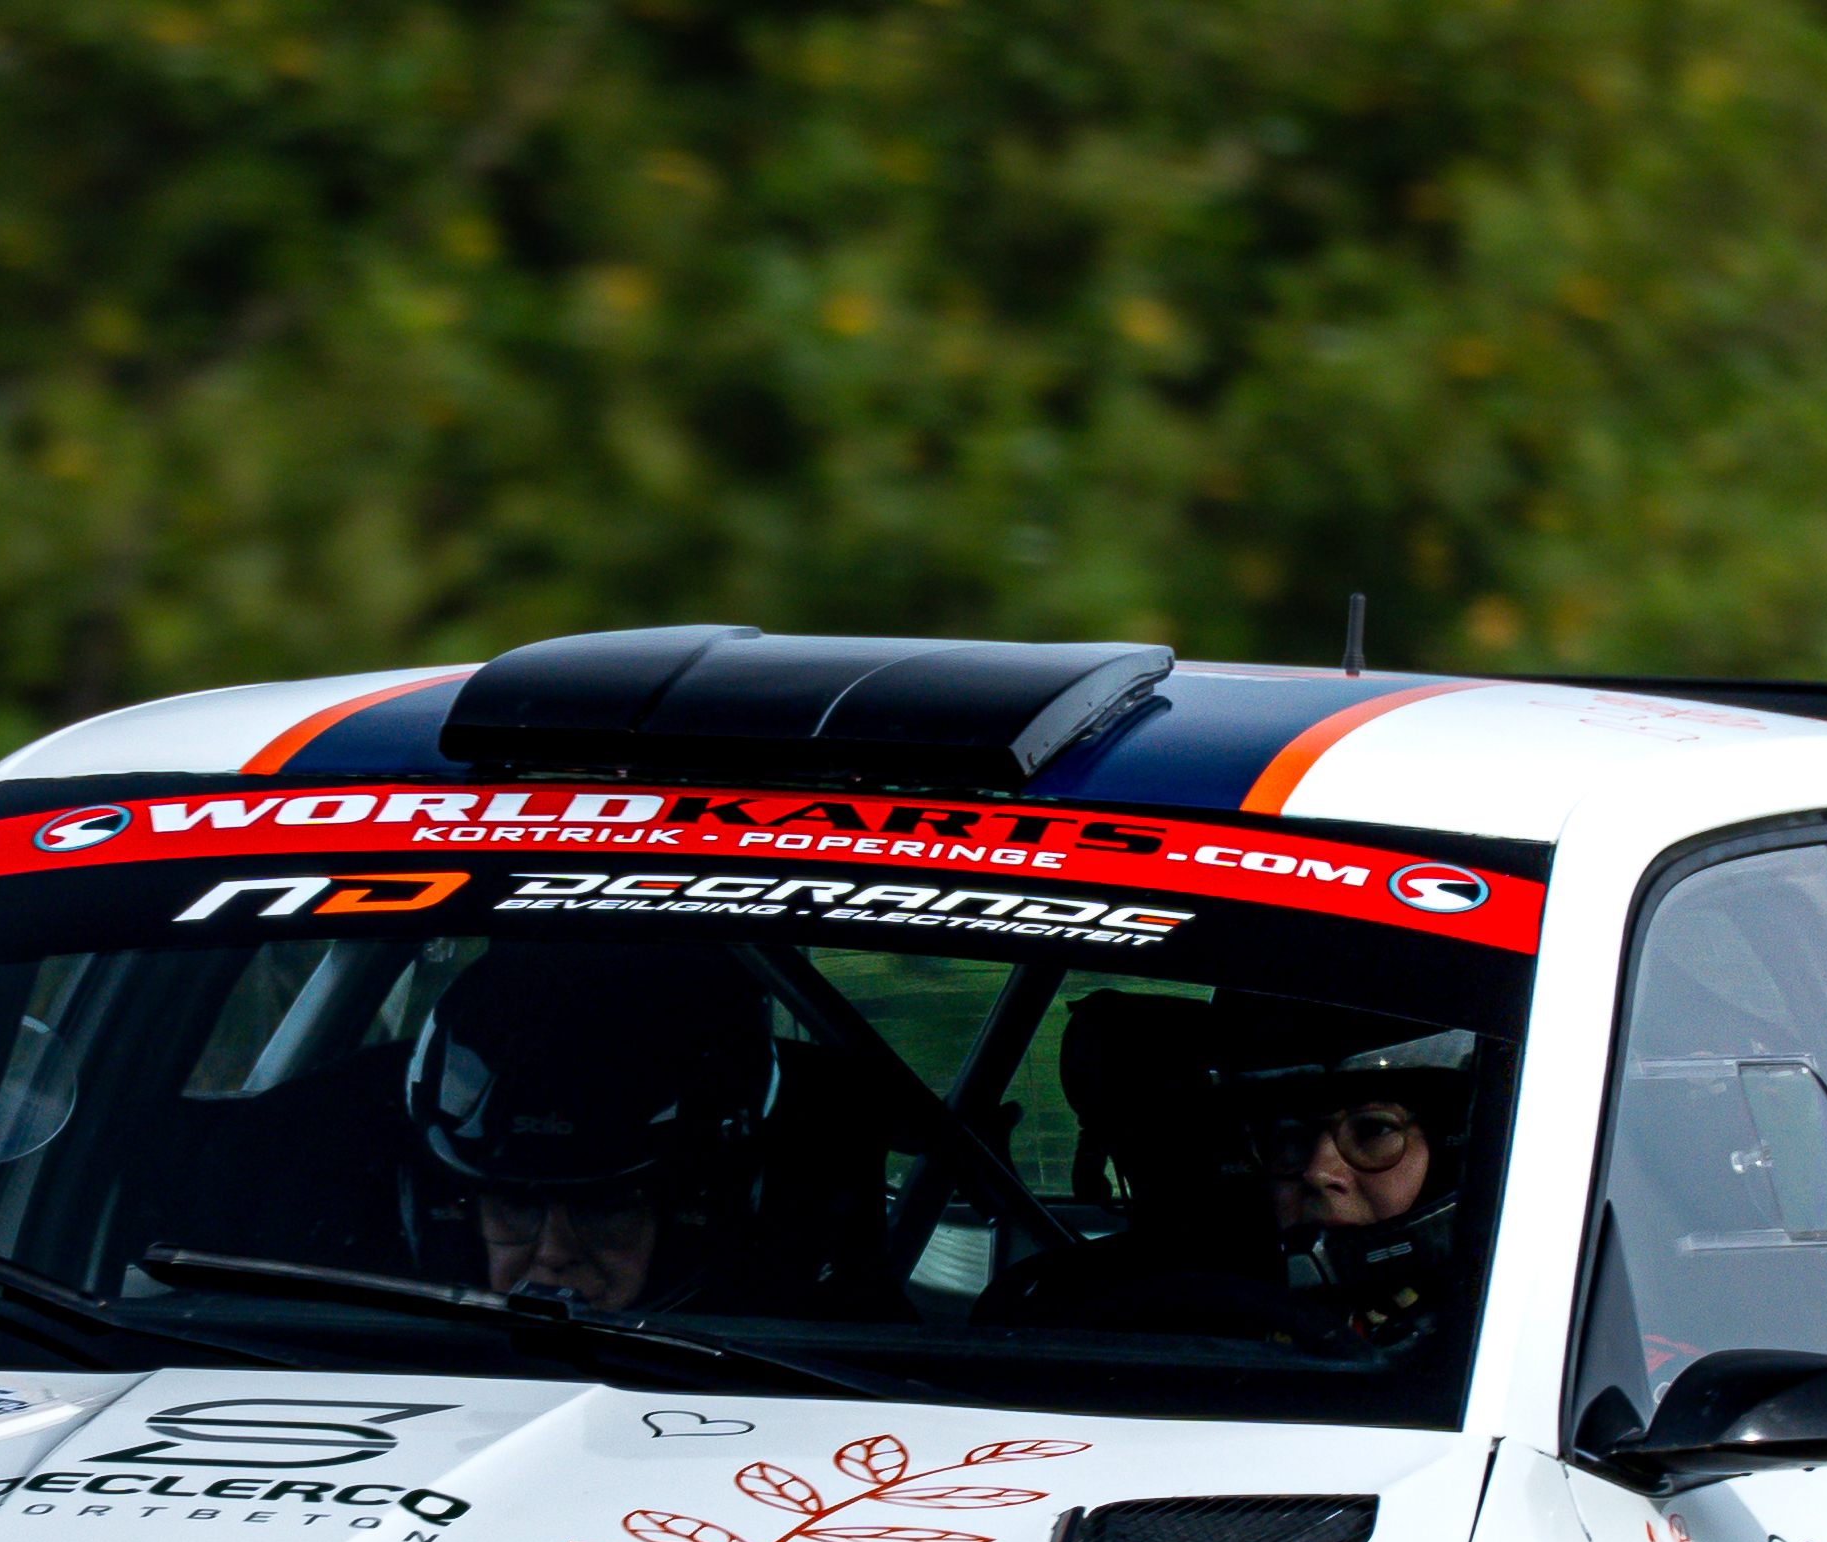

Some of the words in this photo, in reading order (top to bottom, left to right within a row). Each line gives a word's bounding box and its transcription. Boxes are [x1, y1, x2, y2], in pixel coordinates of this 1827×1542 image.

[412, 826, 684, 845] KORTRIJK
[738, 831, 1067, 869] POPERINGE
[493, 899, 788, 915] BEVEILIGING
[822, 908, 1164, 946] ELECTRICITEIT
[510, 873, 1196, 933] DEGRANDE
